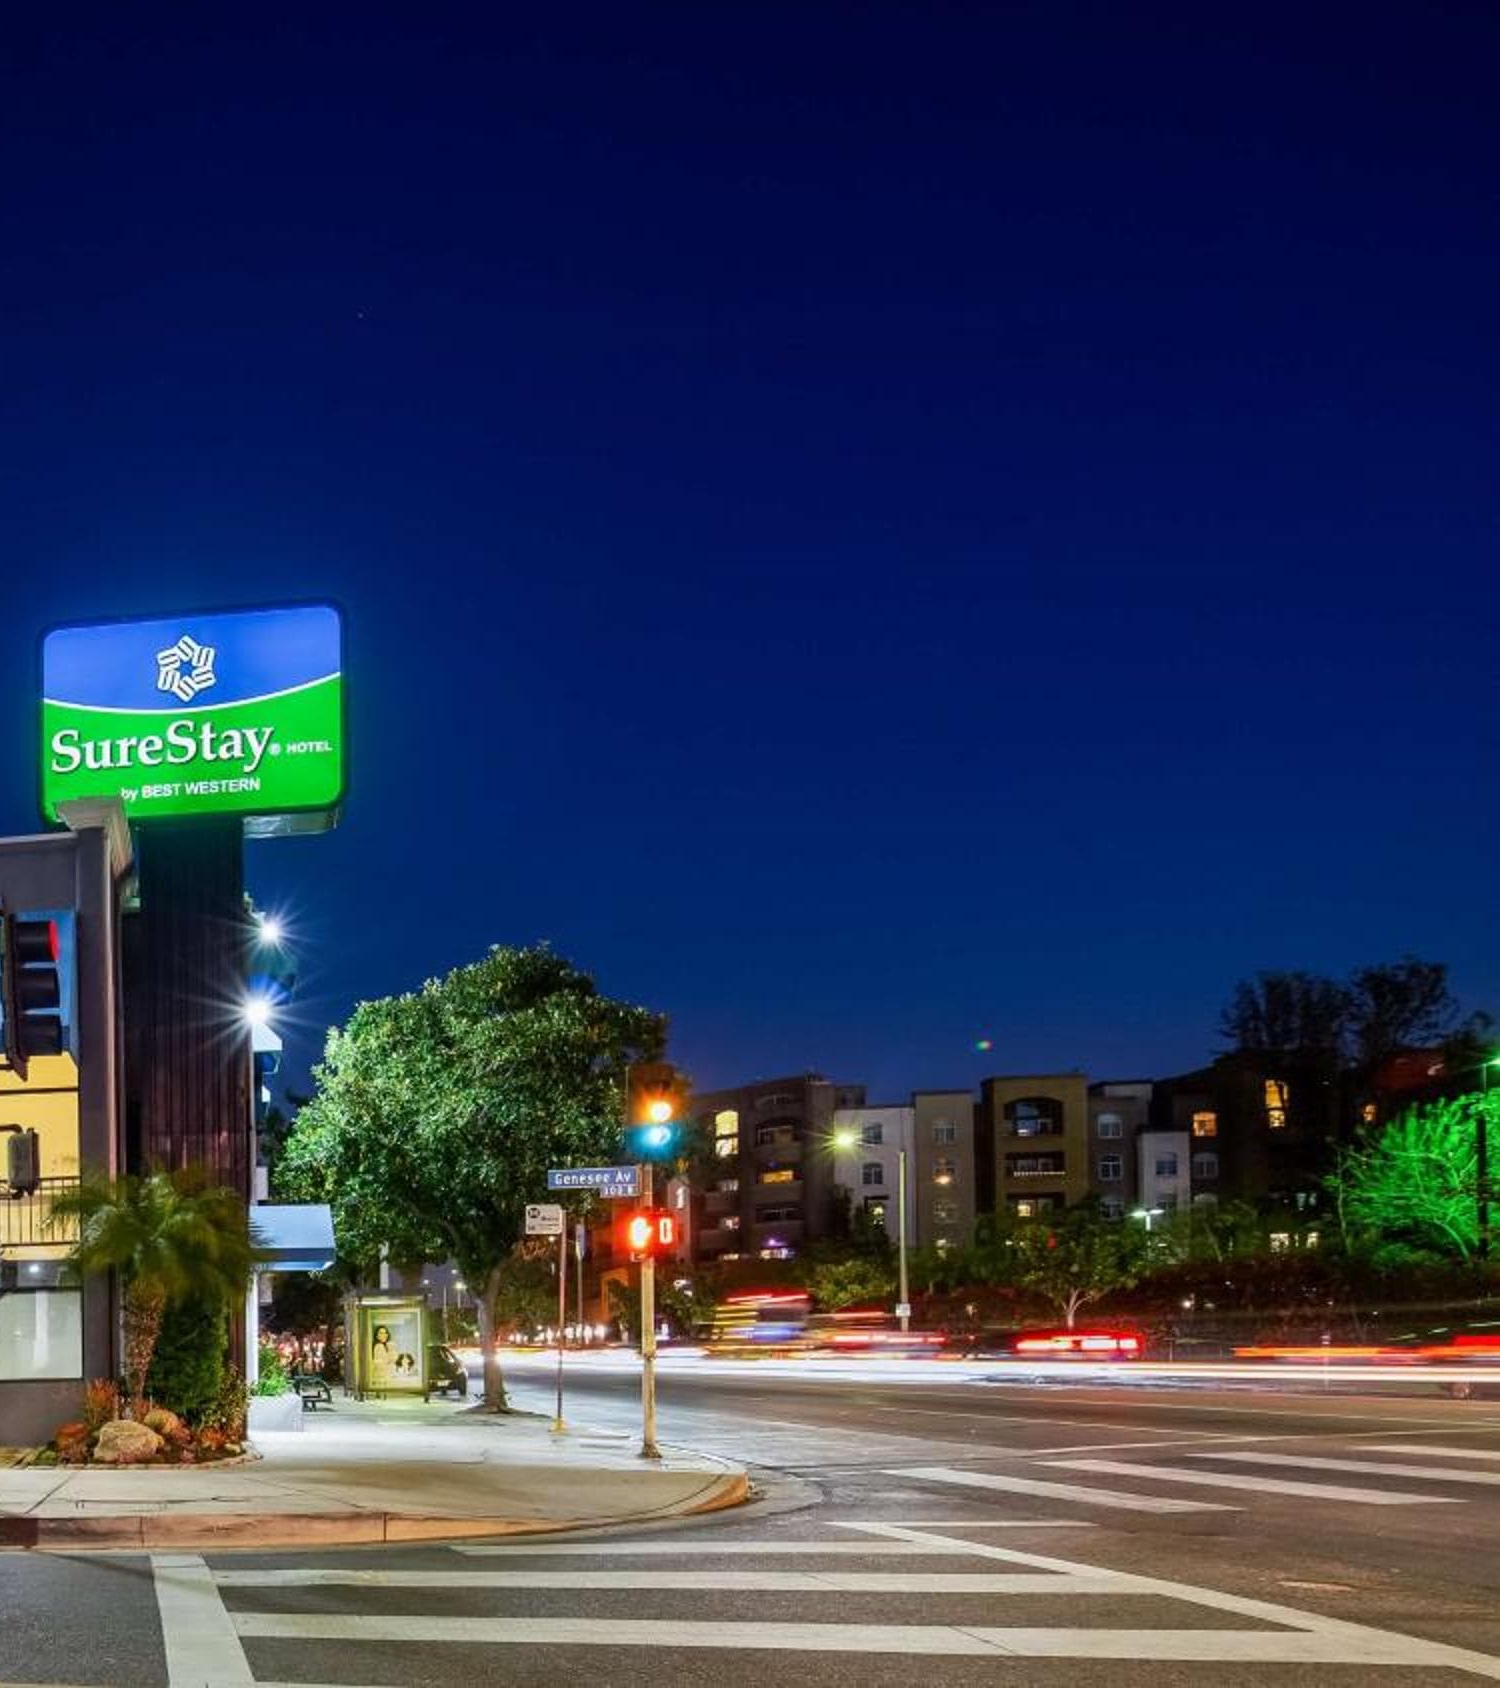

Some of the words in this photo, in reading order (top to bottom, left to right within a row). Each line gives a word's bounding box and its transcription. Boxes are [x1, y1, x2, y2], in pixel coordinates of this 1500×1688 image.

[286, 740, 332, 754] HOTEL
[120, 787, 139, 800] by
[141, 782, 181, 799] BEST
[185, 777, 261, 795] WESTERN
[555, 1172, 610, 1185] Genesee
[615, 1171, 631, 1182] Av
